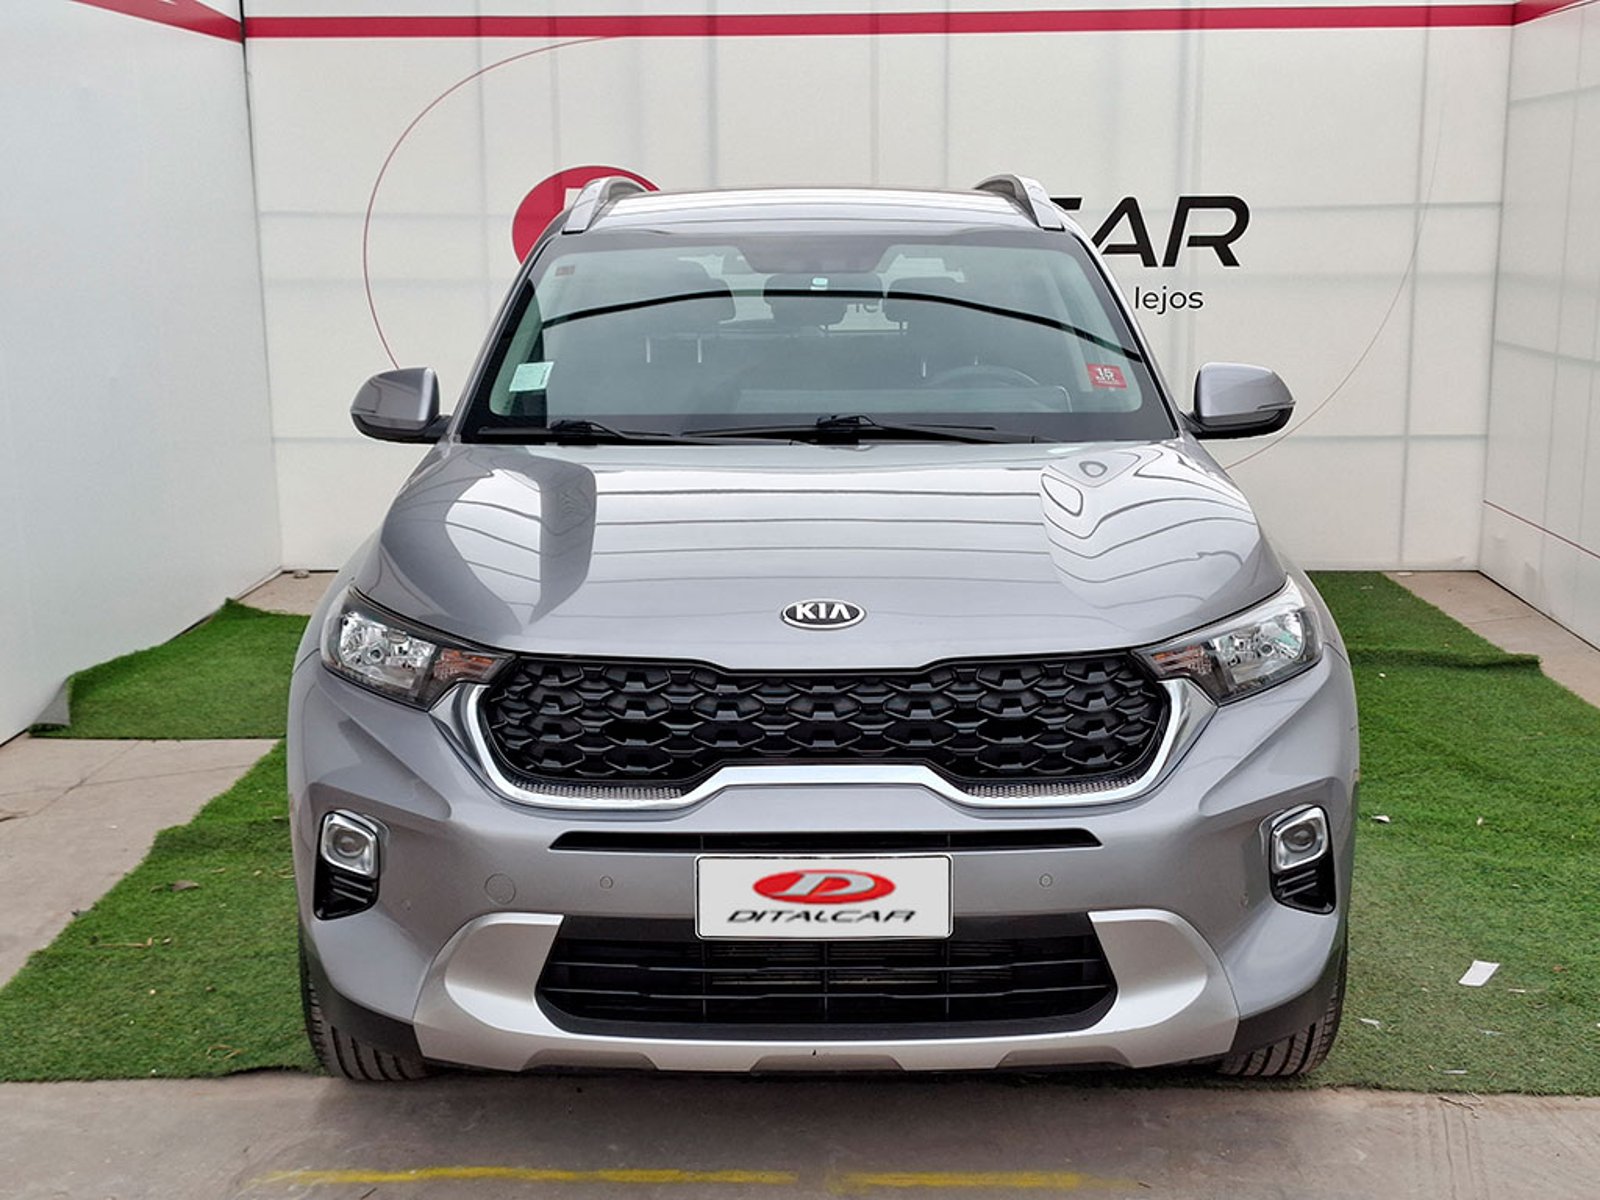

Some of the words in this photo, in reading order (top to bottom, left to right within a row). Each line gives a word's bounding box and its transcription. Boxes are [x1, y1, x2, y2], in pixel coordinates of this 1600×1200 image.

[1050, 196, 1250, 267] AR
[1135, 286, 1204, 315] lejos
[796, 603, 851, 620] KIA
[727, 910, 916, 923] DITALCAR
